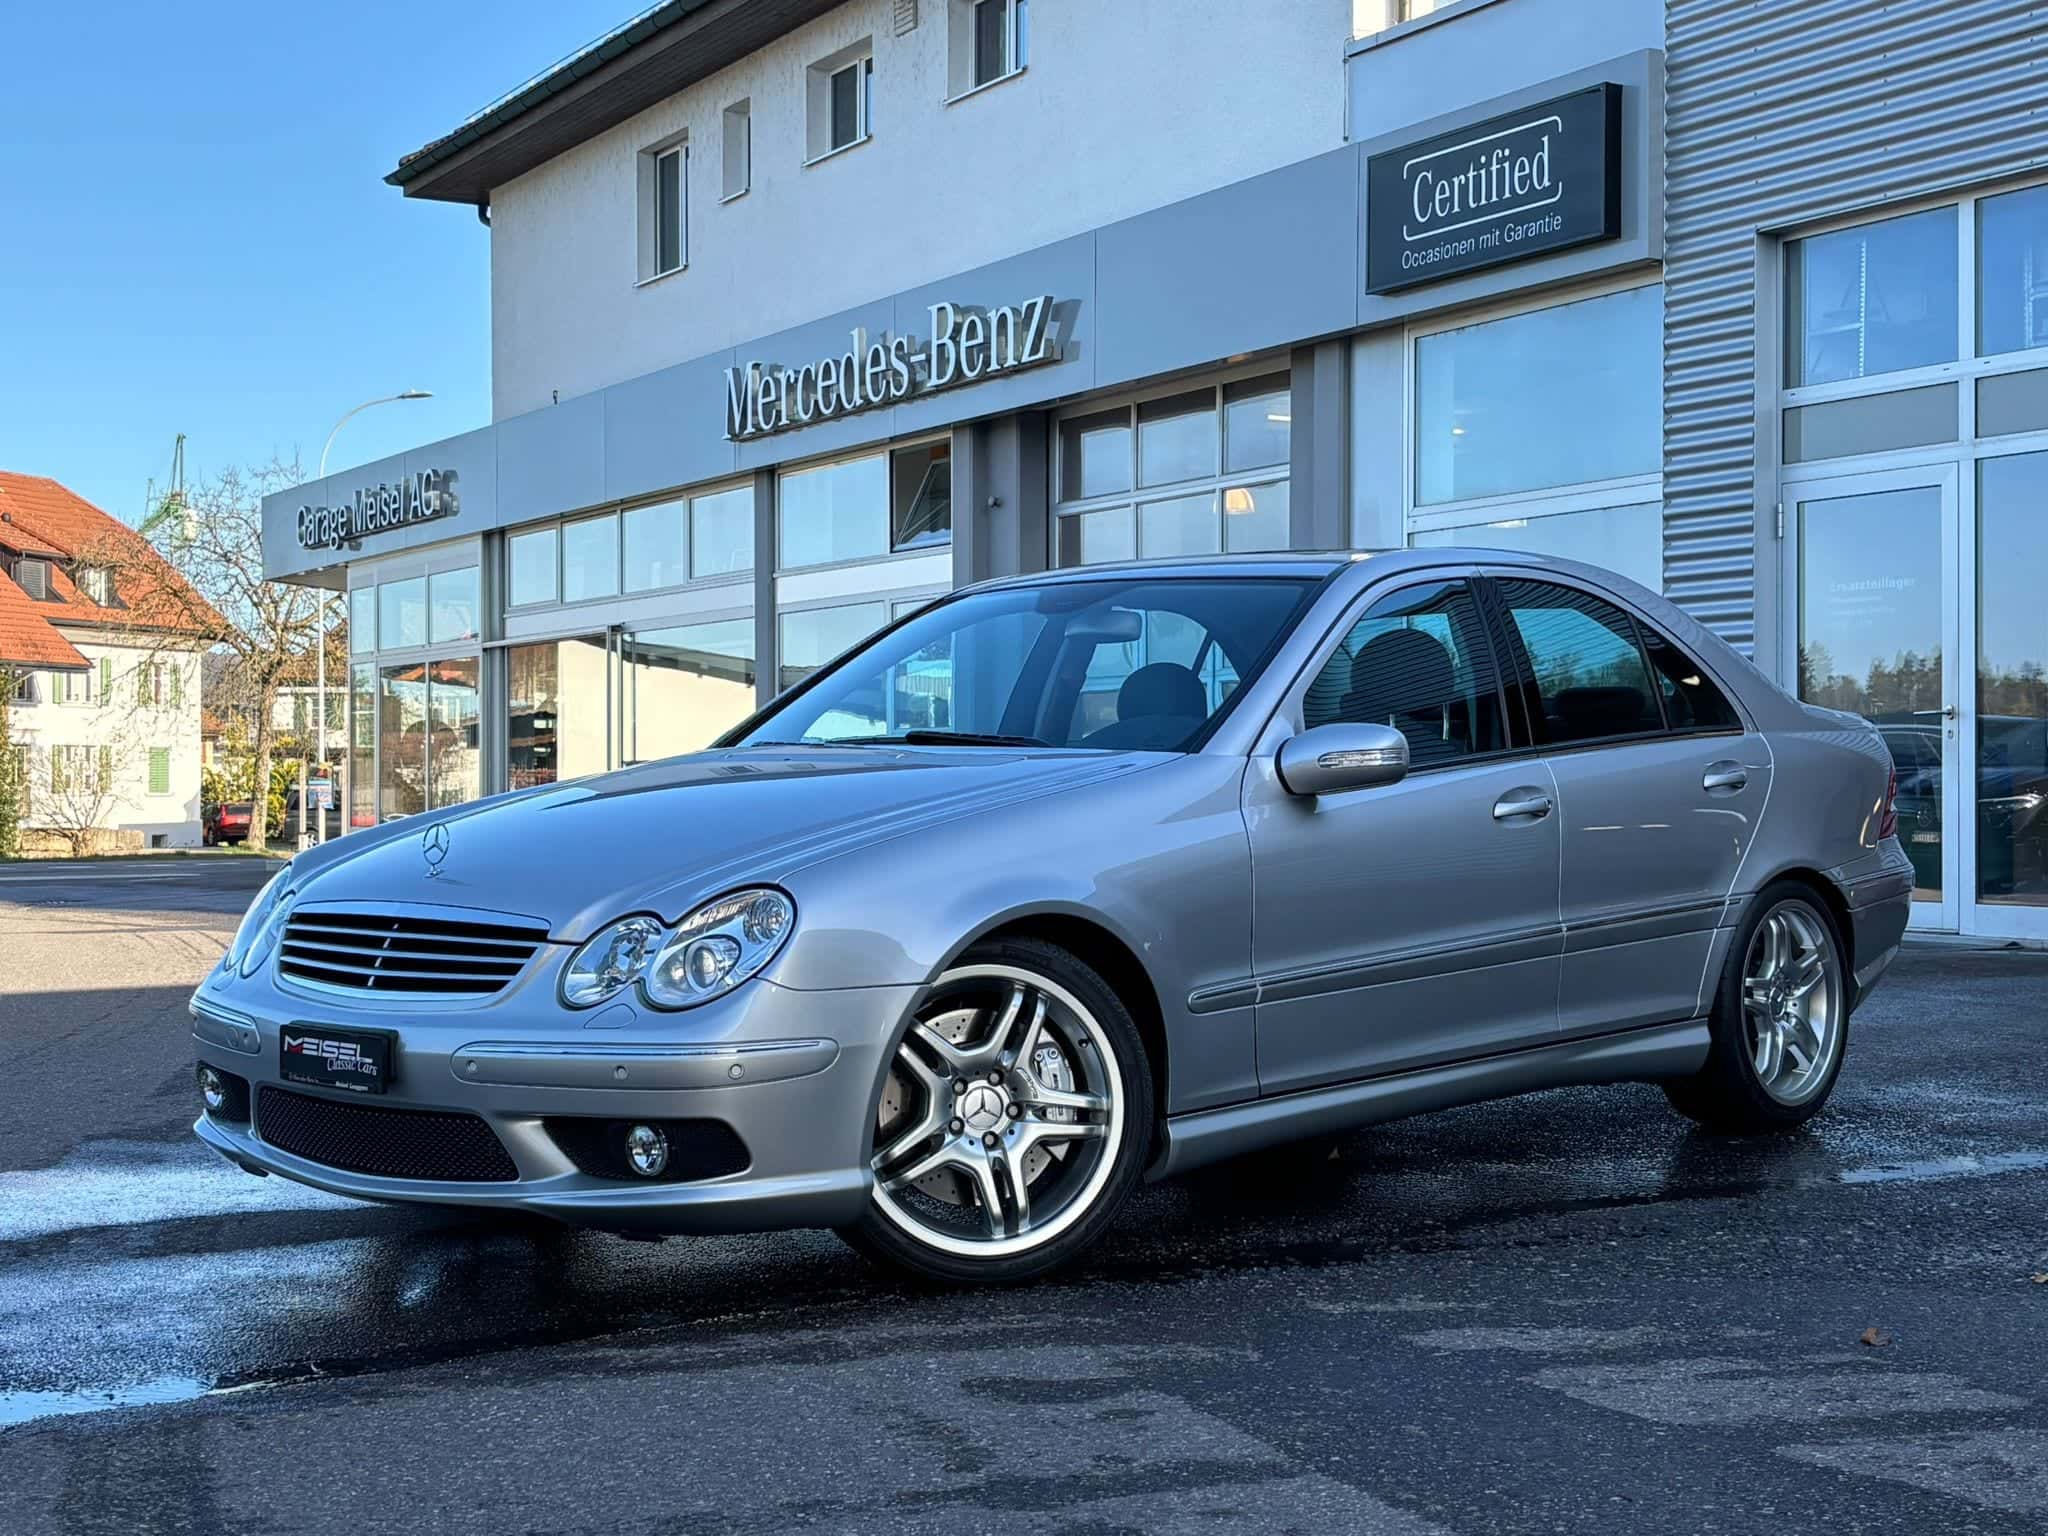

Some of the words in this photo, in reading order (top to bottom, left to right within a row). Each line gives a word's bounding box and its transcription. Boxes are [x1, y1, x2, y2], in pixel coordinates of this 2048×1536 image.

[1412, 134, 1552, 224] Certified
[1401, 238, 1475, 270] Occasionen
[1479, 228, 1501, 249] mit
[1504, 212, 1562, 243] Garantie
[722, 295, 1055, 440] Mercedes-Benz
[296, 505, 347, 550] Garage
[352, 477, 405, 533] Meisel
[409, 468, 436, 520] AG
[283, 1035, 373, 1063] MEISEL
[327, 1058, 357, 1072] Classic
[357, 1059, 379, 1076] Cars
